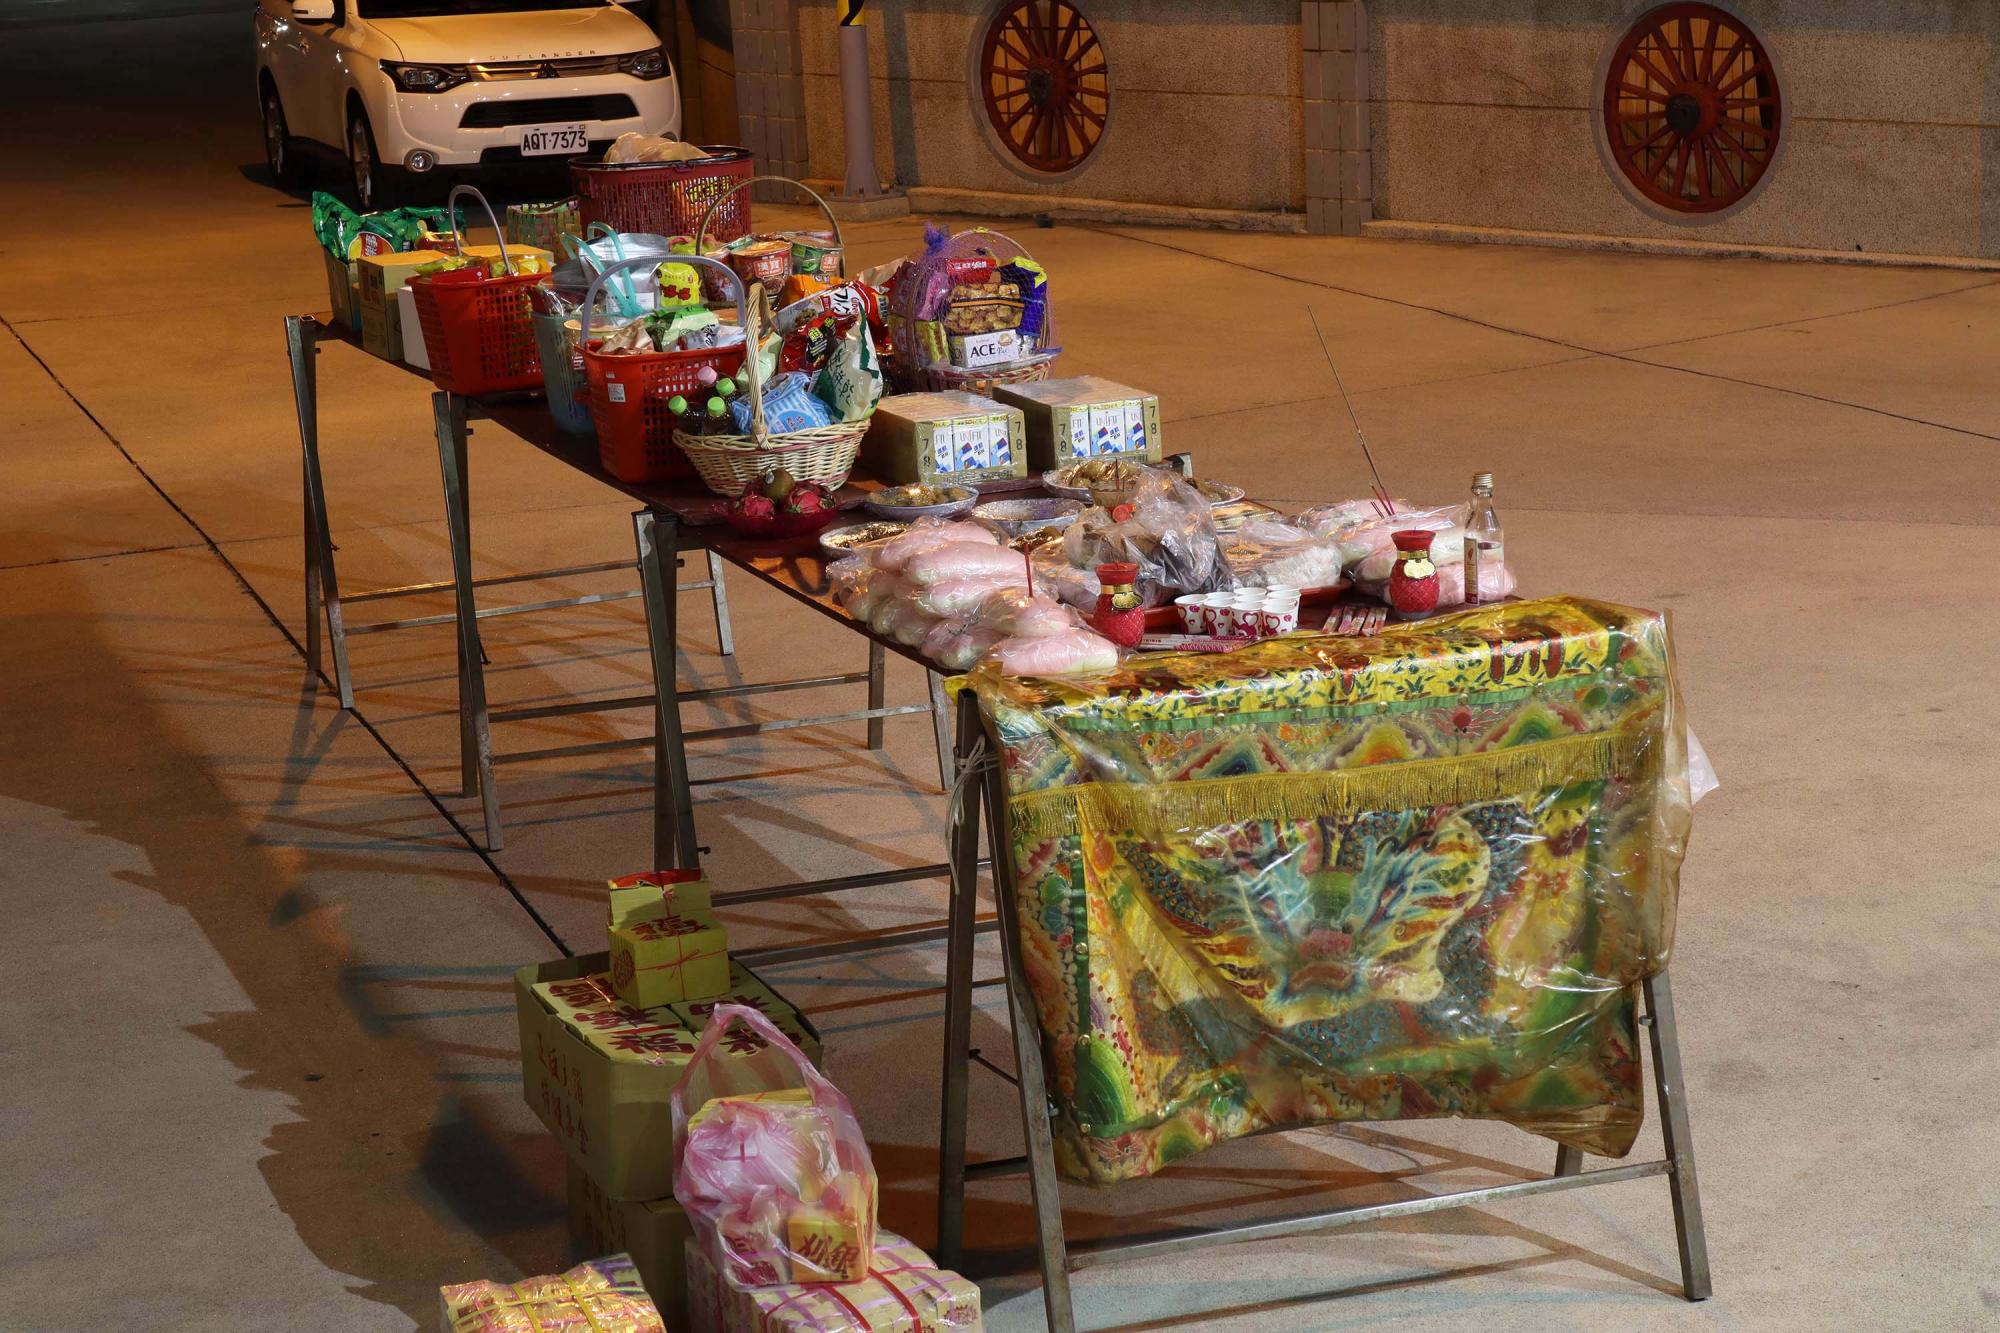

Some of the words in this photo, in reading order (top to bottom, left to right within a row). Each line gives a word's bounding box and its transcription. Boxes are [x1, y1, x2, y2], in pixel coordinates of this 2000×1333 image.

[489, 49, 596, 60] OUTLANDER
[522, 130, 587, 152] AQT-7373
[970, 343, 996, 358] ACE
